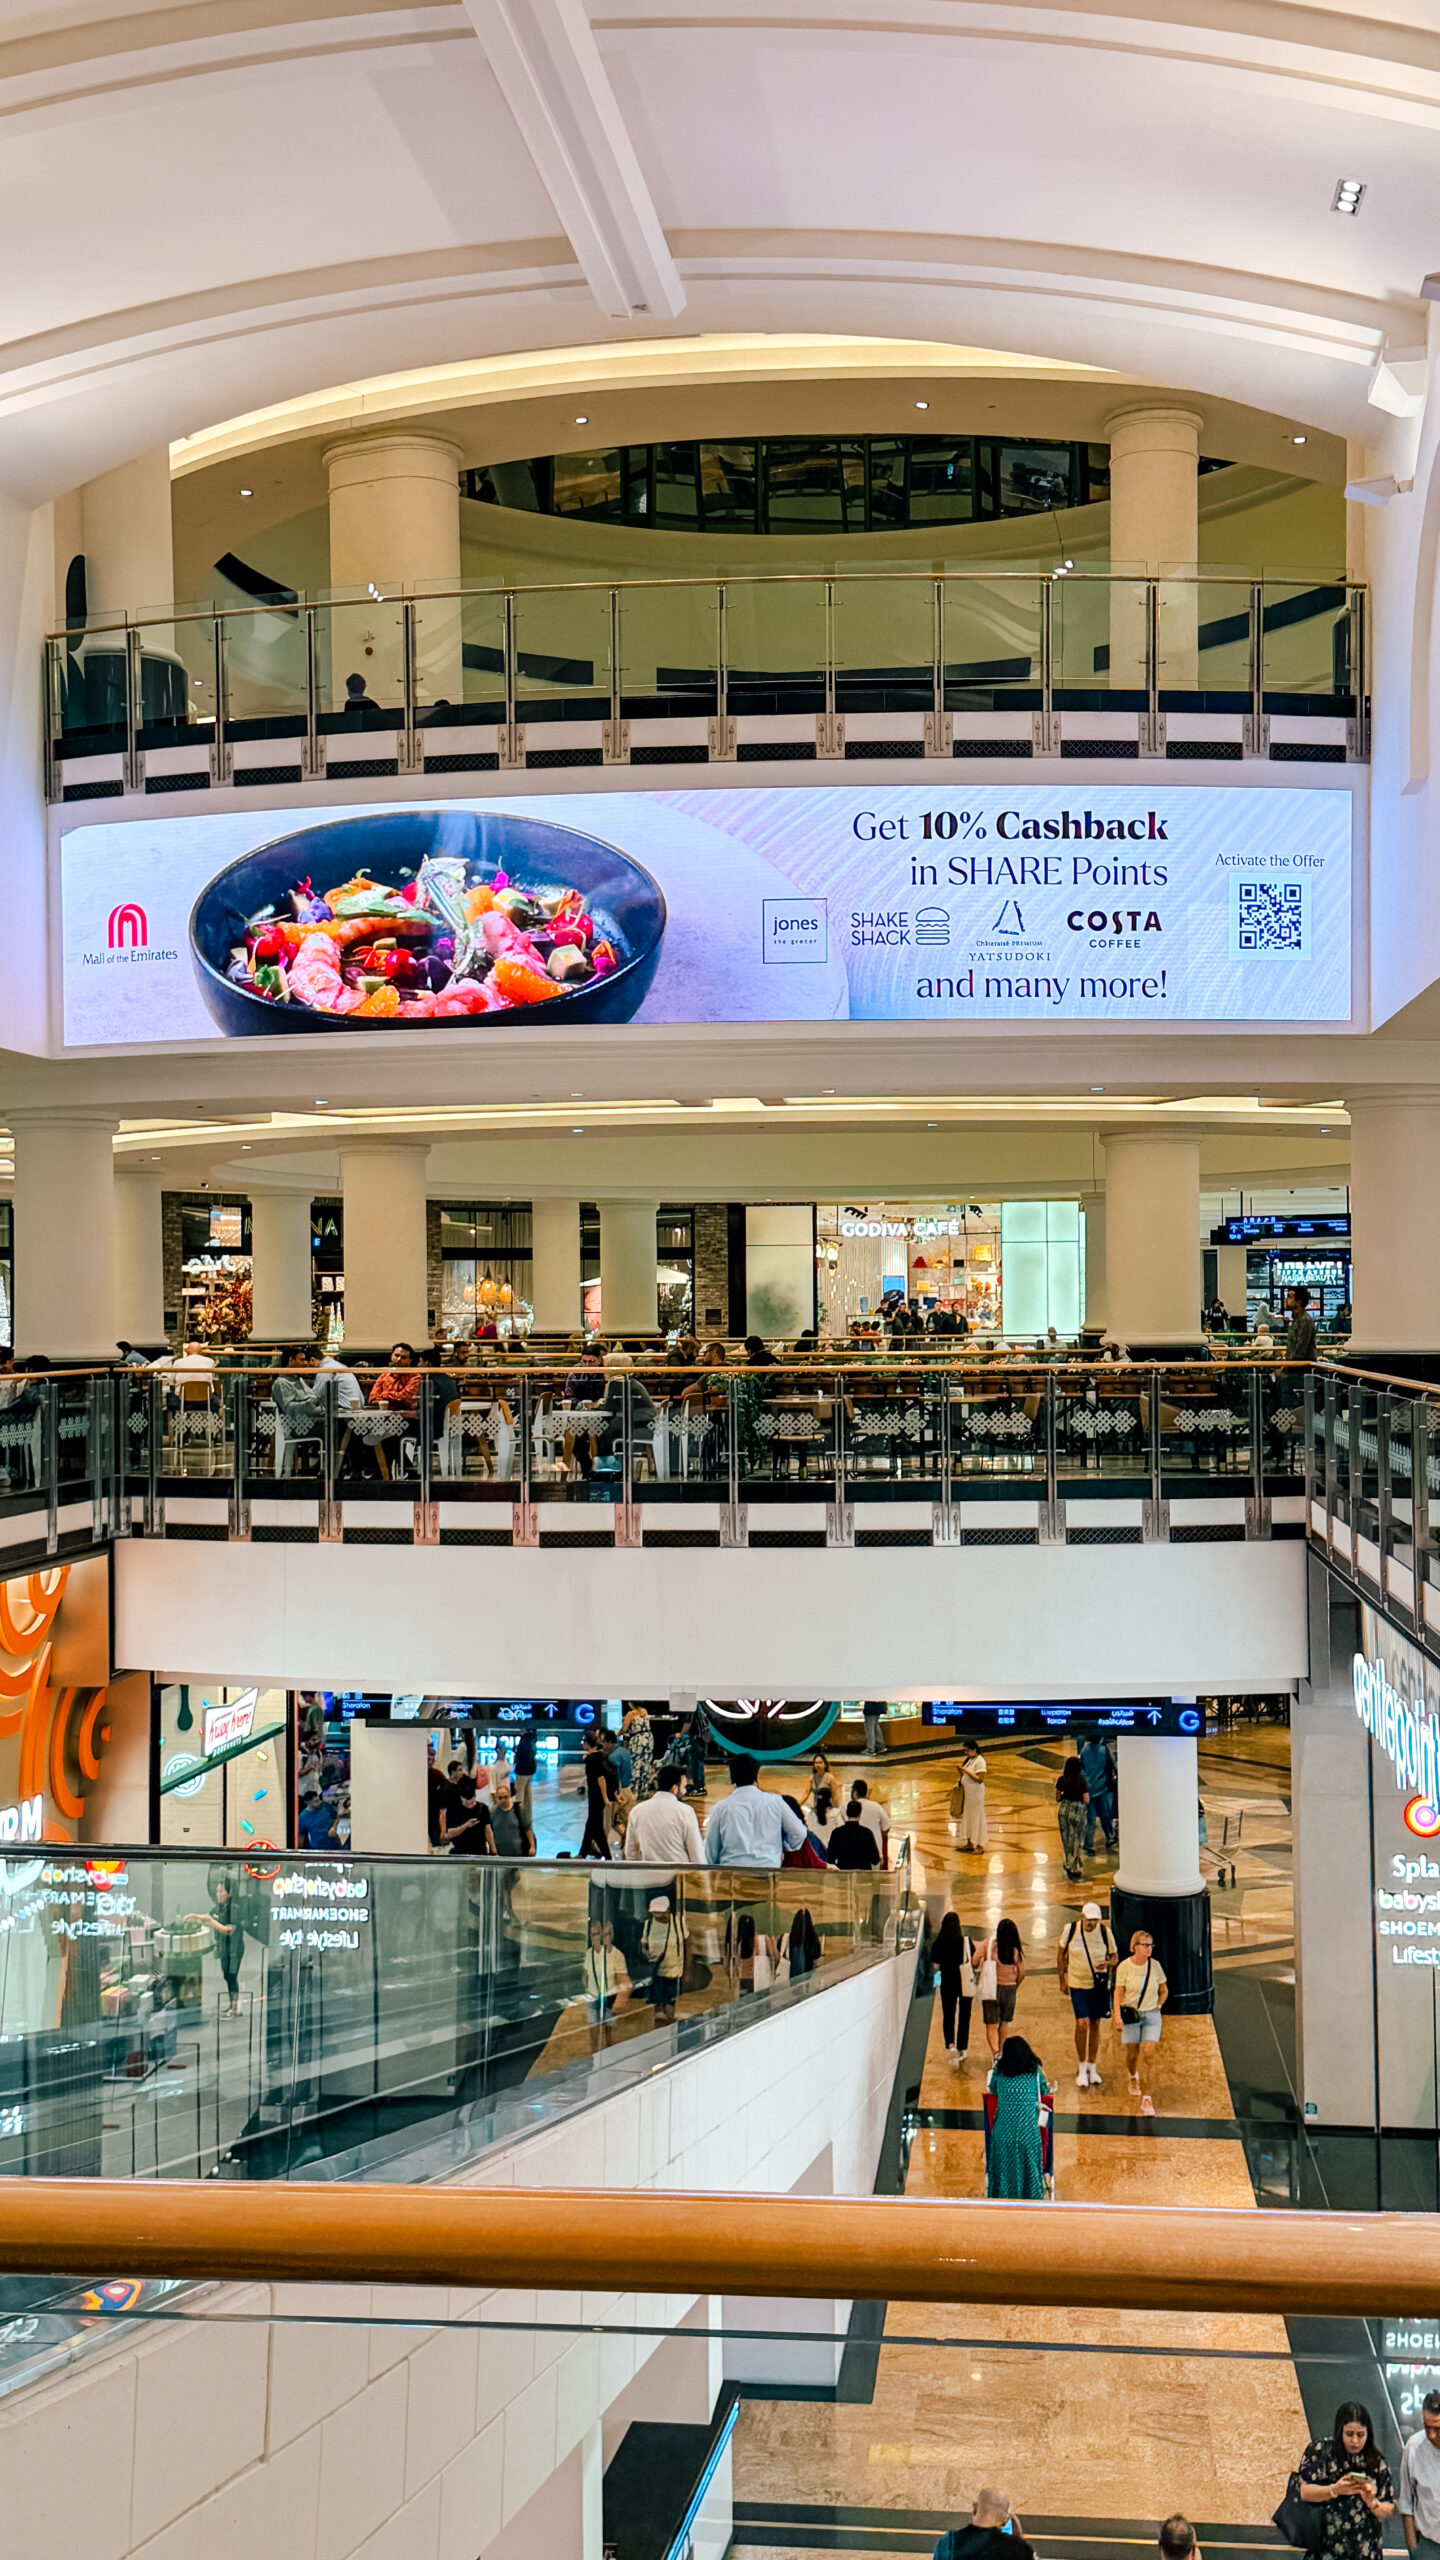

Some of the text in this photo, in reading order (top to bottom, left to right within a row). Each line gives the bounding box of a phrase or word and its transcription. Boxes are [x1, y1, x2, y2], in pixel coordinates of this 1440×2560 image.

[852, 810, 1169, 841] Get 10% Cashback
[1215, 853, 1325, 867] Activate the Offer
[910, 856, 1168, 886] in SHARE Points
[773, 917, 818, 936] jones
[851, 912, 909, 928] SHAKE
[1067, 910, 1162, 934] COSTA
[851, 930, 911, 946] SHACK
[1089, 939, 1141, 948] COFFEE
[82, 949, 178, 966] Mall of the Emirates
[969, 952, 1050, 962] YATSUDOKI
[916, 969, 1167, 1005] and many more!
[841, 1218, 960, 1237] GODIVA CAFÉ
[574, 1703, 595, 1724] G
[932, 1716, 946, 1724] Taxi
[1179, 1710, 1200, 1732] G
